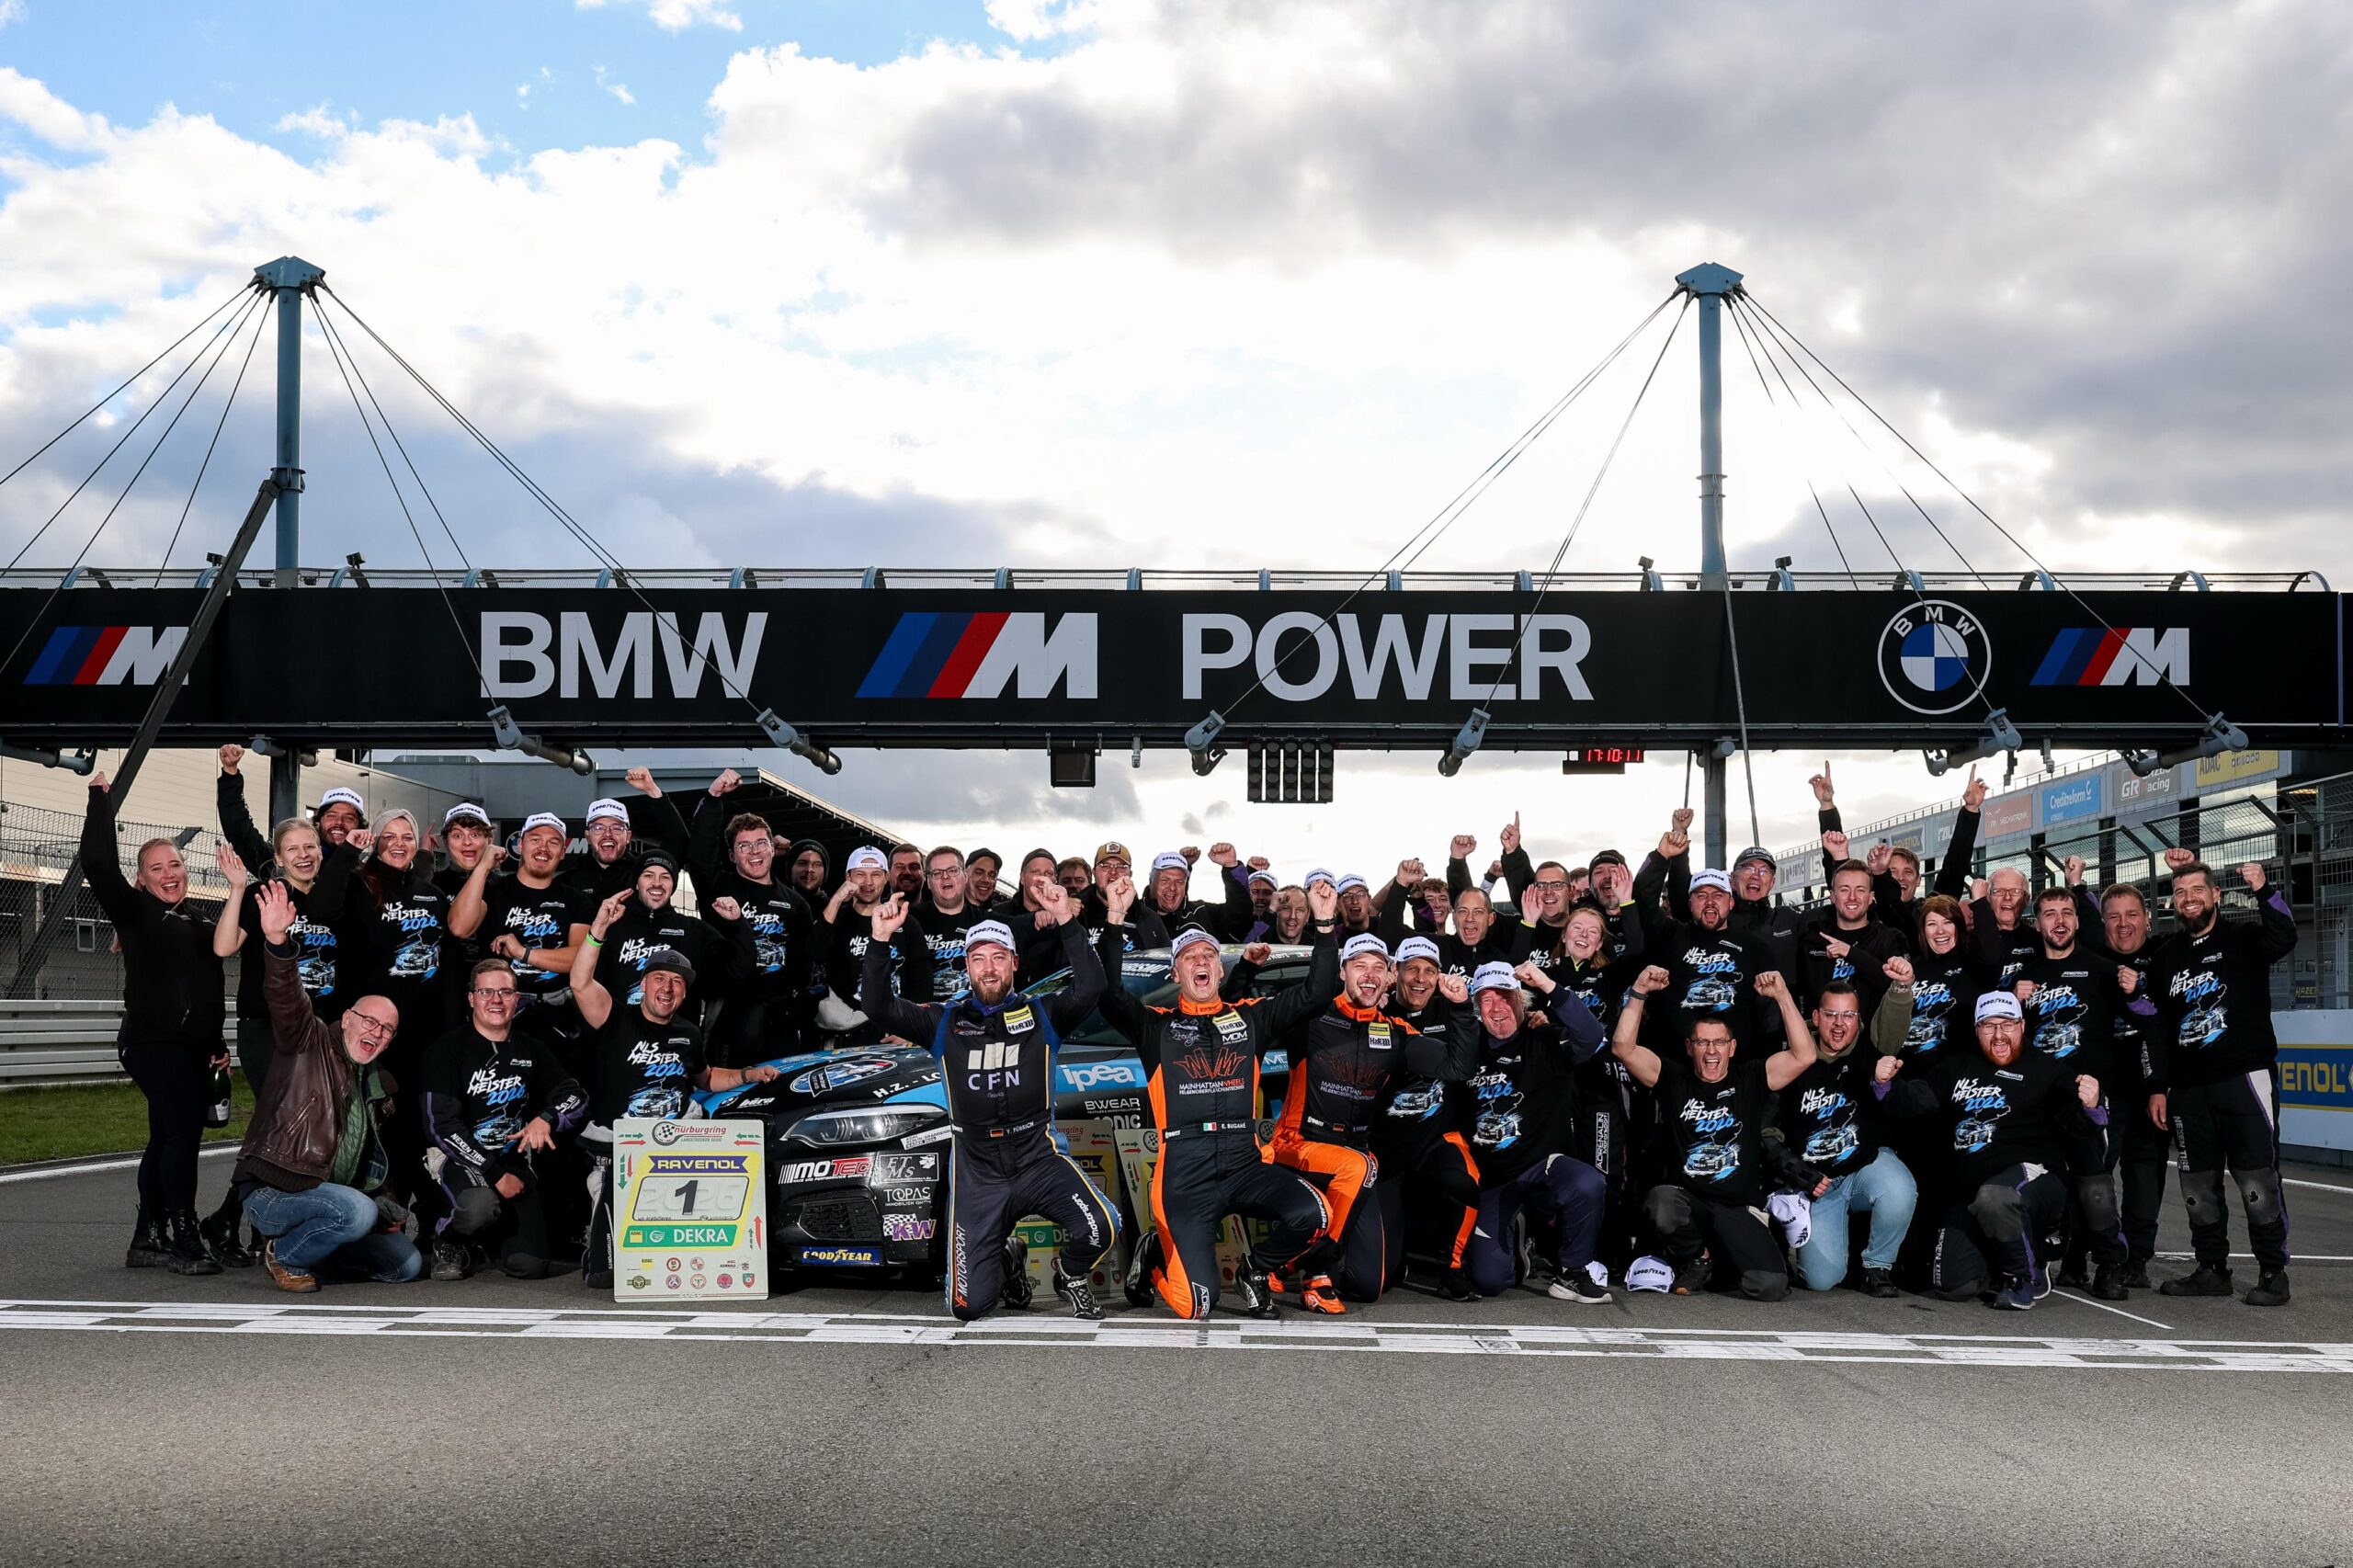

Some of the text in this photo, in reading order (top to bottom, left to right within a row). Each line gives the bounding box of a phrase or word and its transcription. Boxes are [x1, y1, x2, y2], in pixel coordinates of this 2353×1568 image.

[1893, 606, 1976, 638] BMW
[481, 612, 1595, 700] BMW M POWER
[2099, 628, 2189, 686] M
[1587, 748, 1641, 762] 17:10:11
[2121, 779, 2140, 798] GR
[2050, 789, 2086, 810] Creditreform
[592, 803, 623, 812] GOODYEAR
[1694, 873, 1725, 882] GOODYEAR
[381, 908, 432, 923] MEISTER
[508, 906, 531, 917] NLS
[285, 922, 333, 936] MEISTER
[400, 917, 438, 932] 2026
[523, 921, 559, 937] 2026
[970, 926, 1007, 937] GOODYEAR
[303, 934, 337, 947] 2026
[622, 937, 645, 952] NLS
[1350, 938, 1385, 950] GOODYEAR
[1404, 944, 1438, 955] GOODYEAR
[1529, 949, 1550, 960] NLS
[1683, 951, 1731, 966] MEISTER
[1698, 960, 1735, 973] 2026
[1476, 970, 1510, 982] GOODYEAR
[2172, 968, 2190, 986] NLS
[2169, 970, 2214, 998] MEISTER
[2184, 977, 2220, 1004] 2026
[1980, 997, 2013, 1009] GOODYEAR
[2039, 995, 2078, 1015] 2026
[633, 1040, 660, 1054] NLS
[627, 1051, 682, 1065] MEISTER
[471, 1067, 496, 1083] NLS
[644, 1062, 686, 1077] 2026
[467, 1074, 523, 1096] MEISTER
[1060, 1064, 1137, 1092] ipea
[1954, 1077, 1978, 1090] NLS
[486, 1084, 527, 1106] 2026
[873, 1081, 909, 1098] H.Z.
[1477, 1084, 1514, 1100] 2026
[1802, 1086, 1825, 1102] NLS
[1951, 1085, 2002, 1102] MEISTER
[1085, 1097, 1141, 1110] BWEAR
[1964, 1095, 2006, 1111] 2026
[1680, 1105, 1729, 1122] MEISTER
[675, 1125, 727, 1135] nürburgring
[1695, 1117, 1735, 1132] 2026
[2173, 1115, 2186, 1148] NEXEN
[450, 1132, 487, 1164] NEXEN TIRE
[657, 1159, 740, 1169] RAVENOL
[675, 1180, 699, 1215] 1
[883, 1187, 931, 1202] TOPAS
[674, 1228, 729, 1243] DEKRA
[892, 1220, 937, 1241] KW
[957, 1222, 969, 1297] MOTORSPORT
[1633, 1267, 1667, 1277] GOODYEAR
